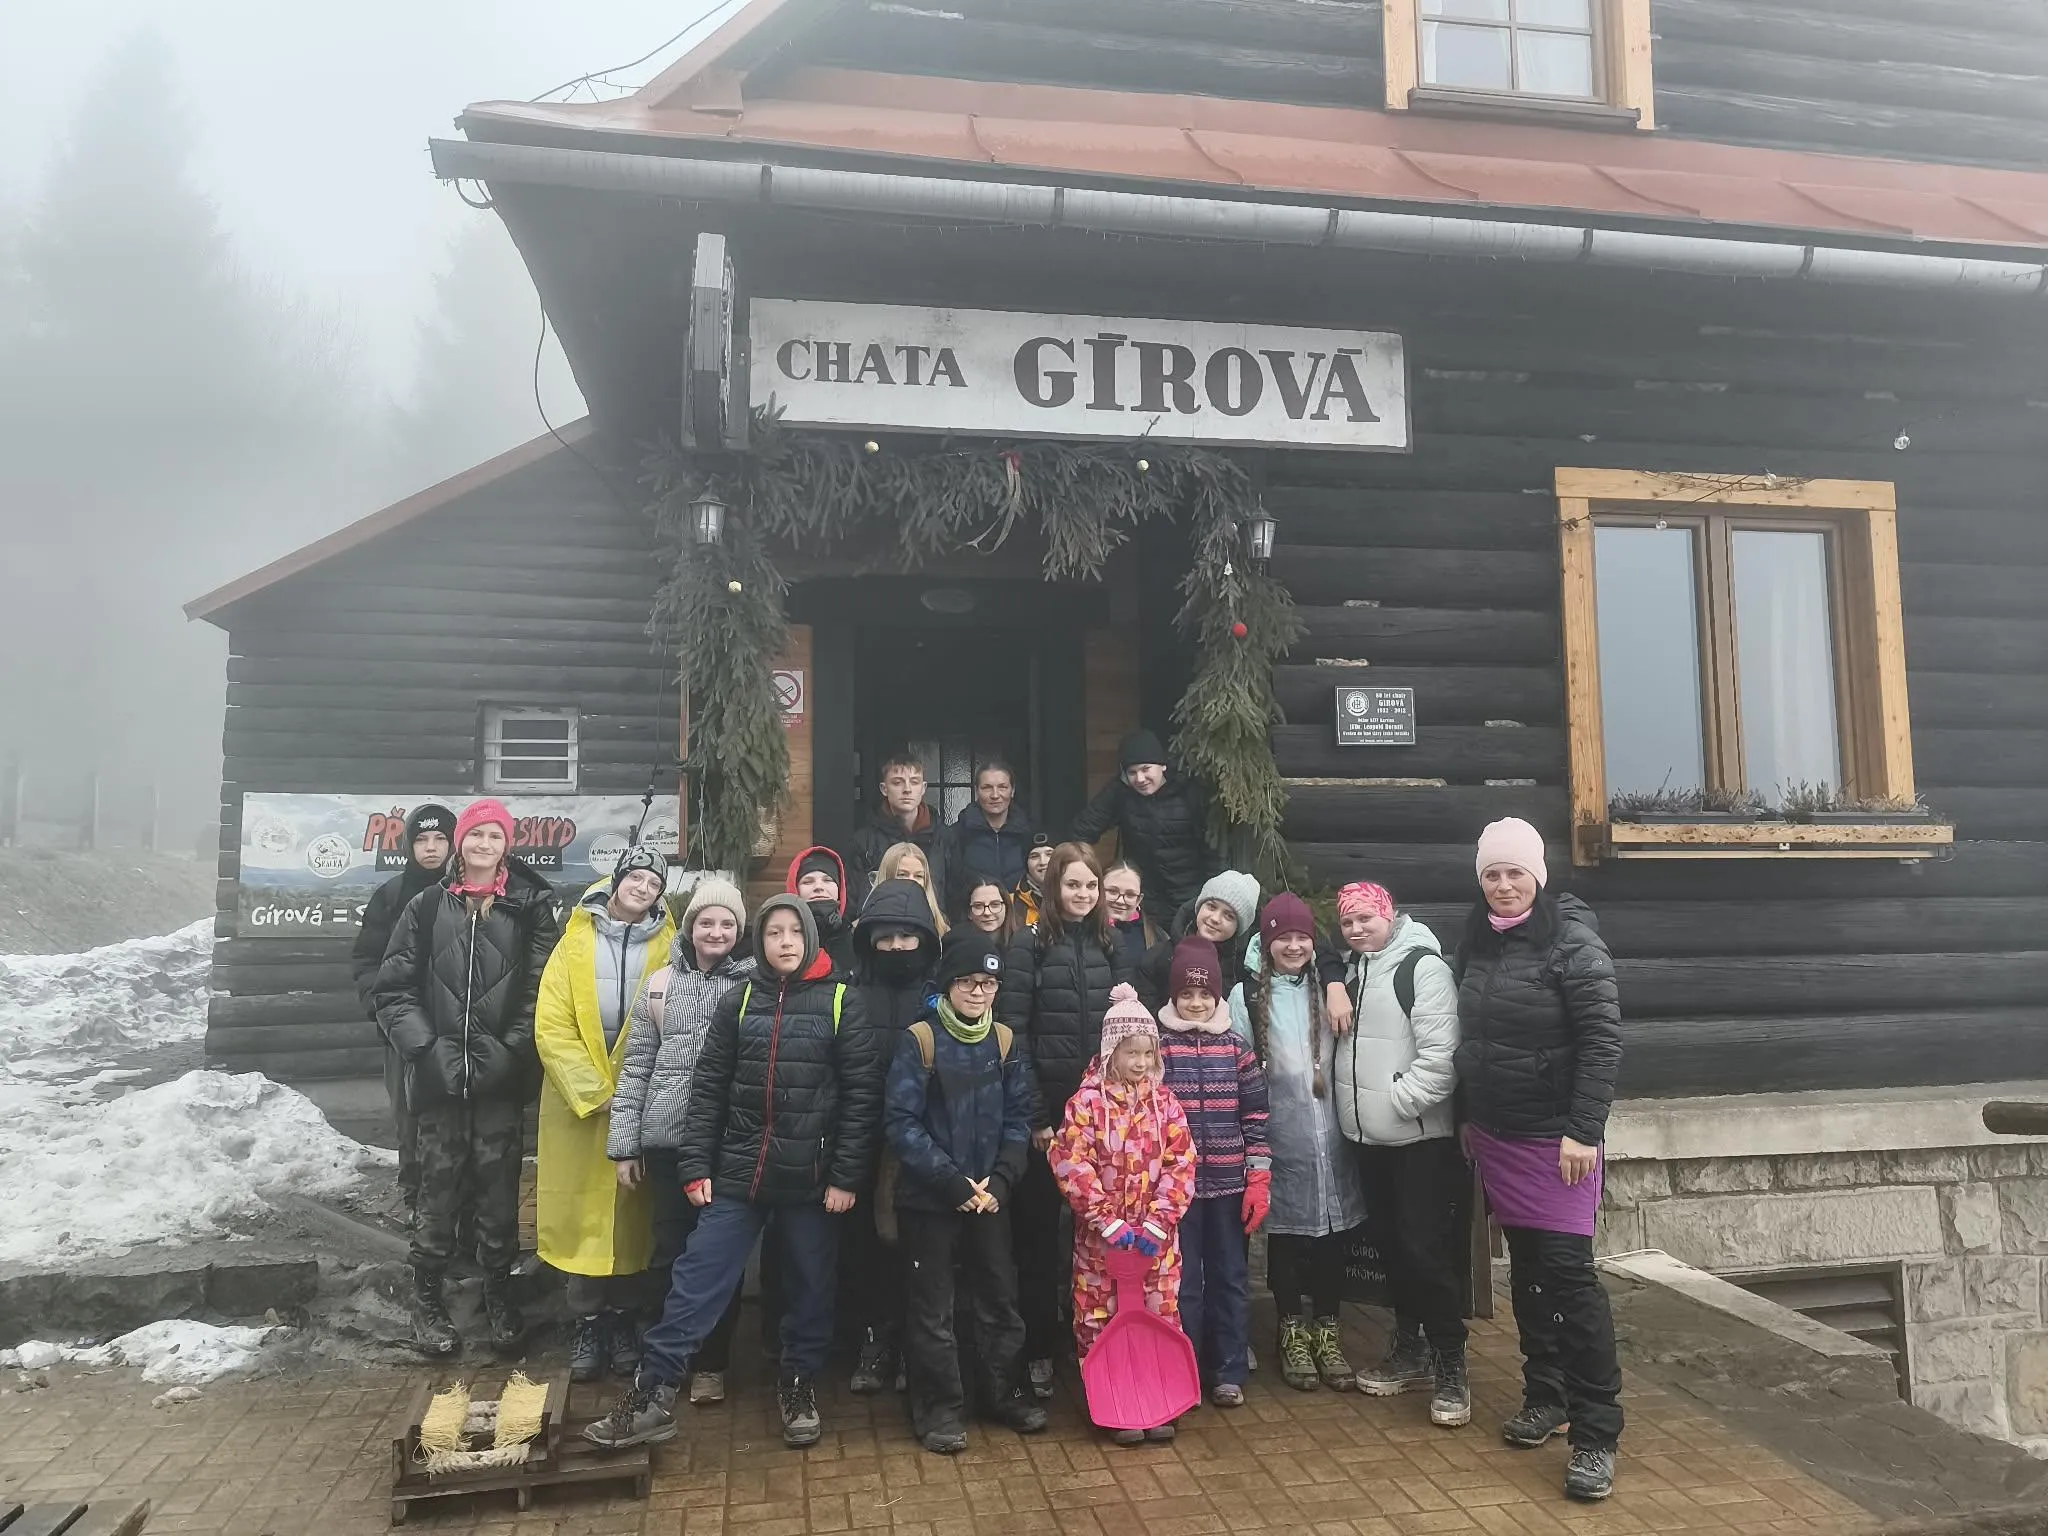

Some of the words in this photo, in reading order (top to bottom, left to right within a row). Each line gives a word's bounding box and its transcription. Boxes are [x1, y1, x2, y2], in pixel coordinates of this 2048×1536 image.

[776, 339, 968, 387] CHATA
[512, 816, 576, 849] SKYD
[251, 903, 323, 926] Gírová
